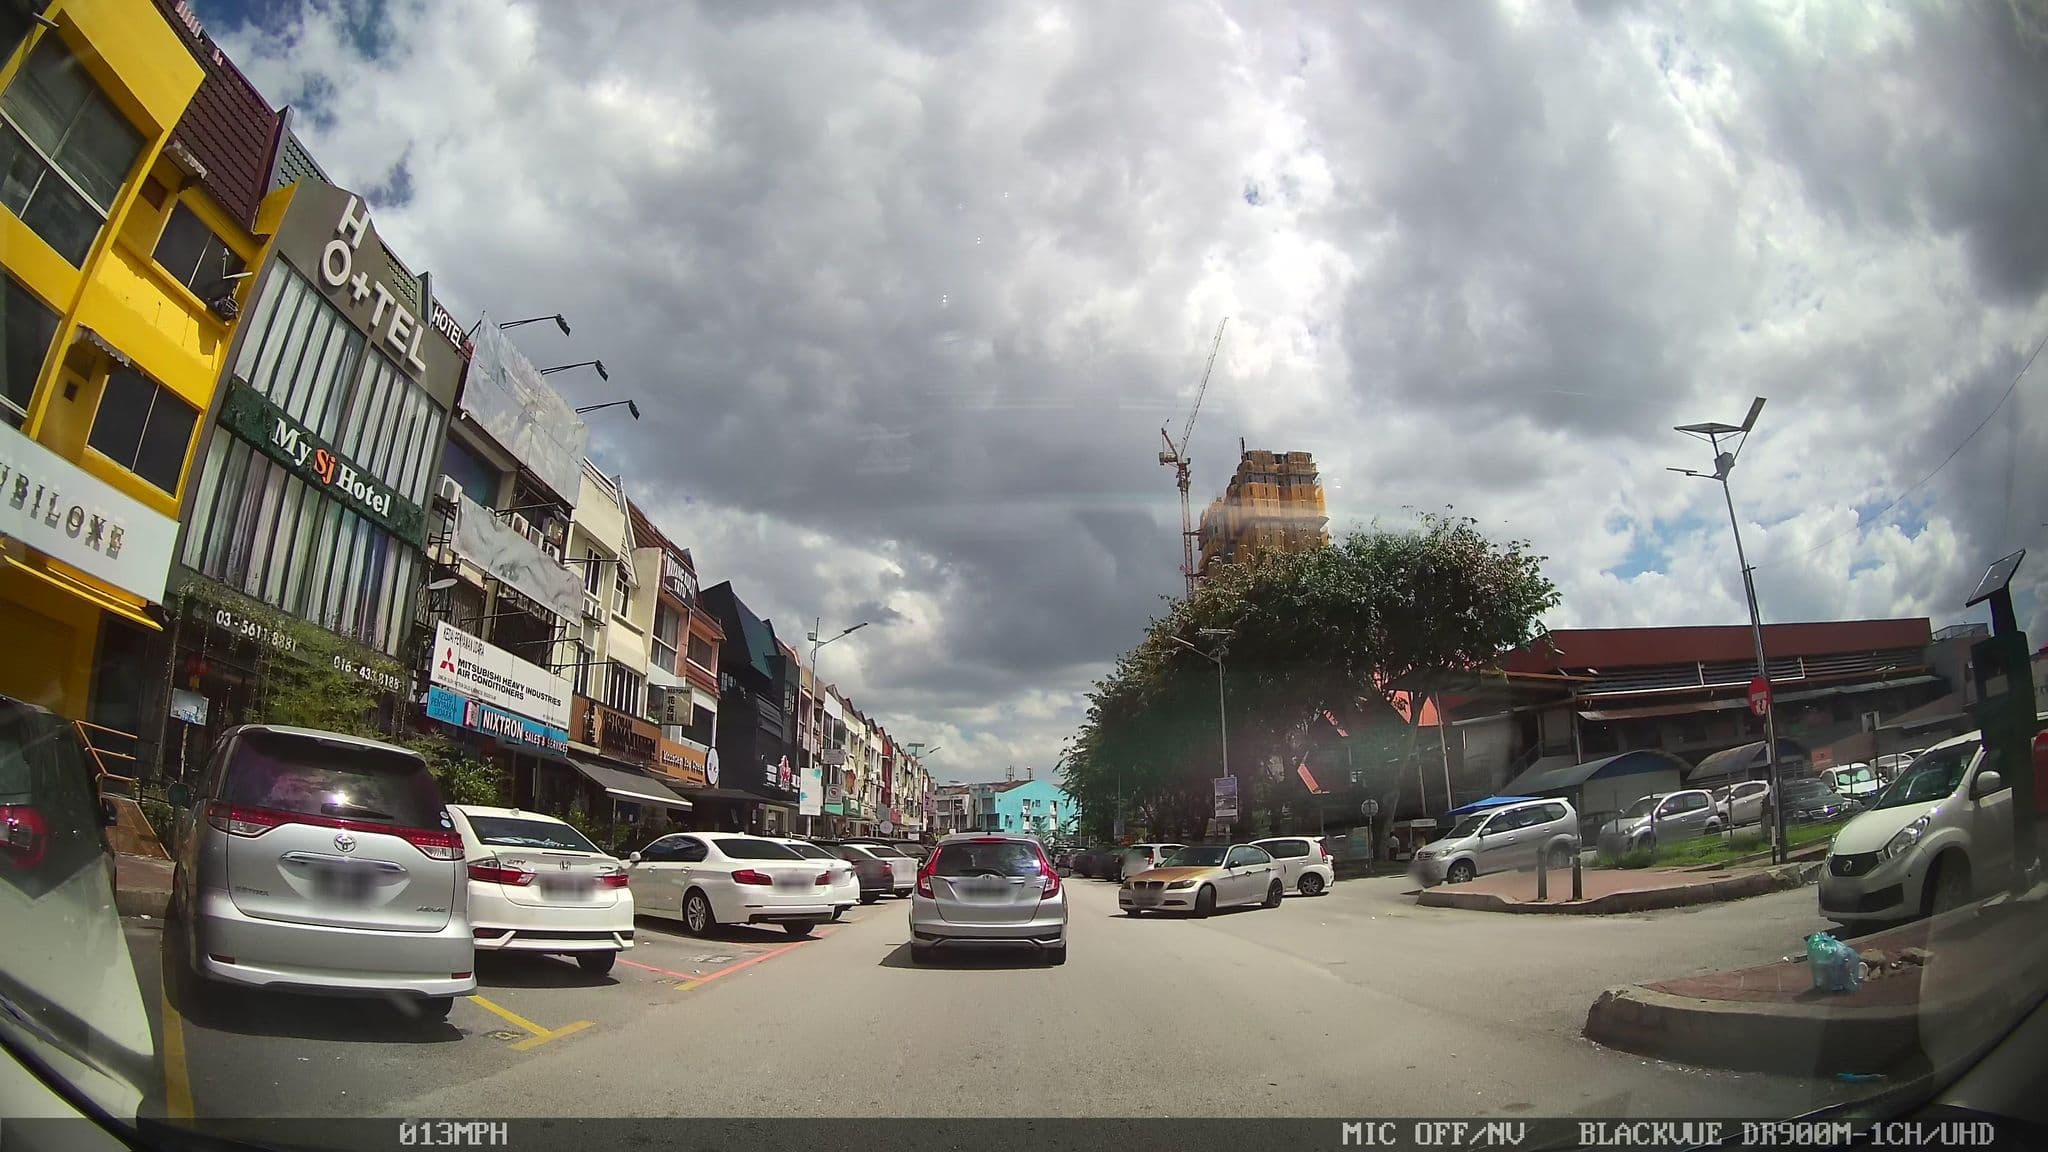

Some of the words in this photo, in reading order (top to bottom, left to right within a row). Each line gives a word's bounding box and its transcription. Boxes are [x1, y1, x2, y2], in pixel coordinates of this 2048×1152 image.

[432, 305, 462, 349] HOTEL
[272, 418, 312, 466] My
[314, 448, 336, 485] Sj
[336, 463, 391, 518] Hotel
[457, 668, 470, 680] AIR
[471, 673, 524, 700] CONDITIONERS
[458, 658, 502, 682] MITSUBISHI
[502, 677, 525, 692] HEAVY
[525, 687, 562, 707] INDUSTRIES
[482, 710, 523, 740] NIXTRON
[525, 731, 540, 745] SALES
[547, 738, 568, 753] SERVICES
